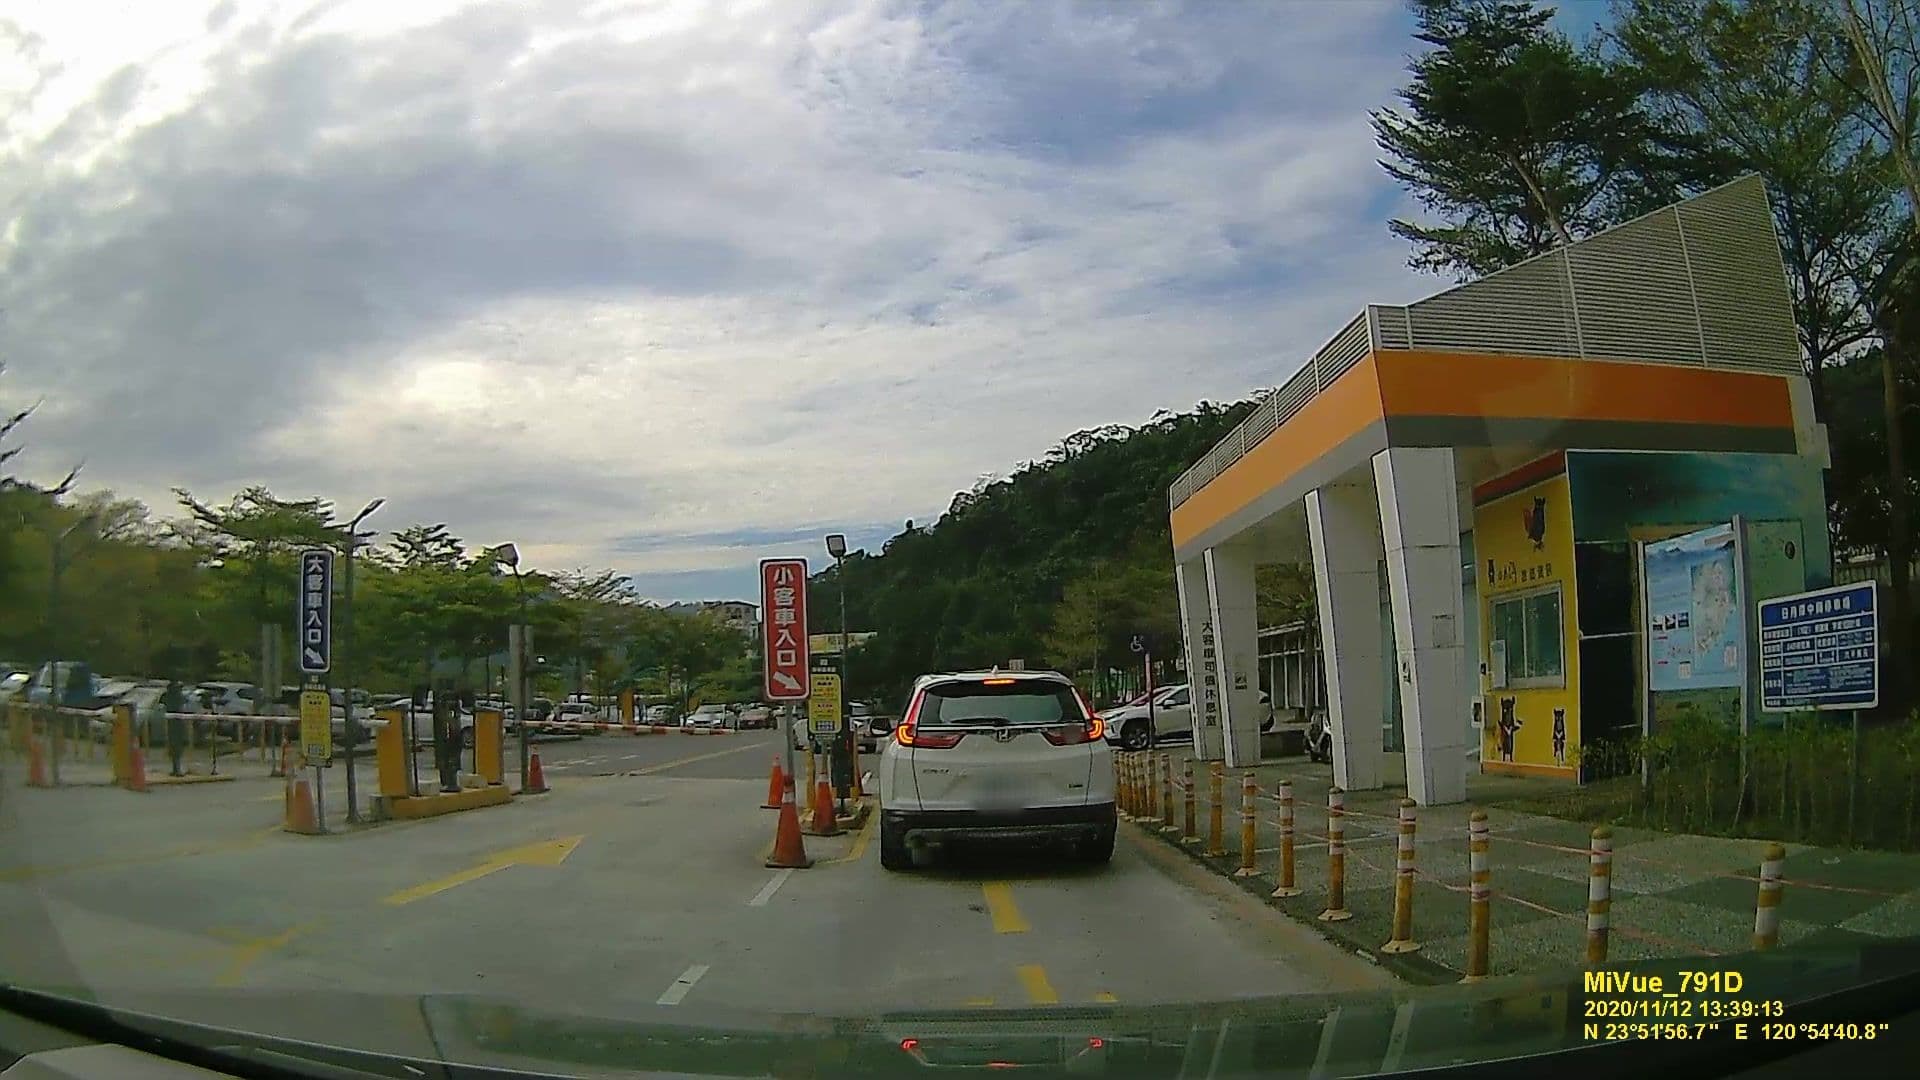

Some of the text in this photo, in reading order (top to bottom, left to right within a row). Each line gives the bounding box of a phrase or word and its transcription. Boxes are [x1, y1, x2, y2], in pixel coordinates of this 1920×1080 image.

[307, 556, 324, 643] 大客車入口
[773, 566, 797, 667] 小客車入口
